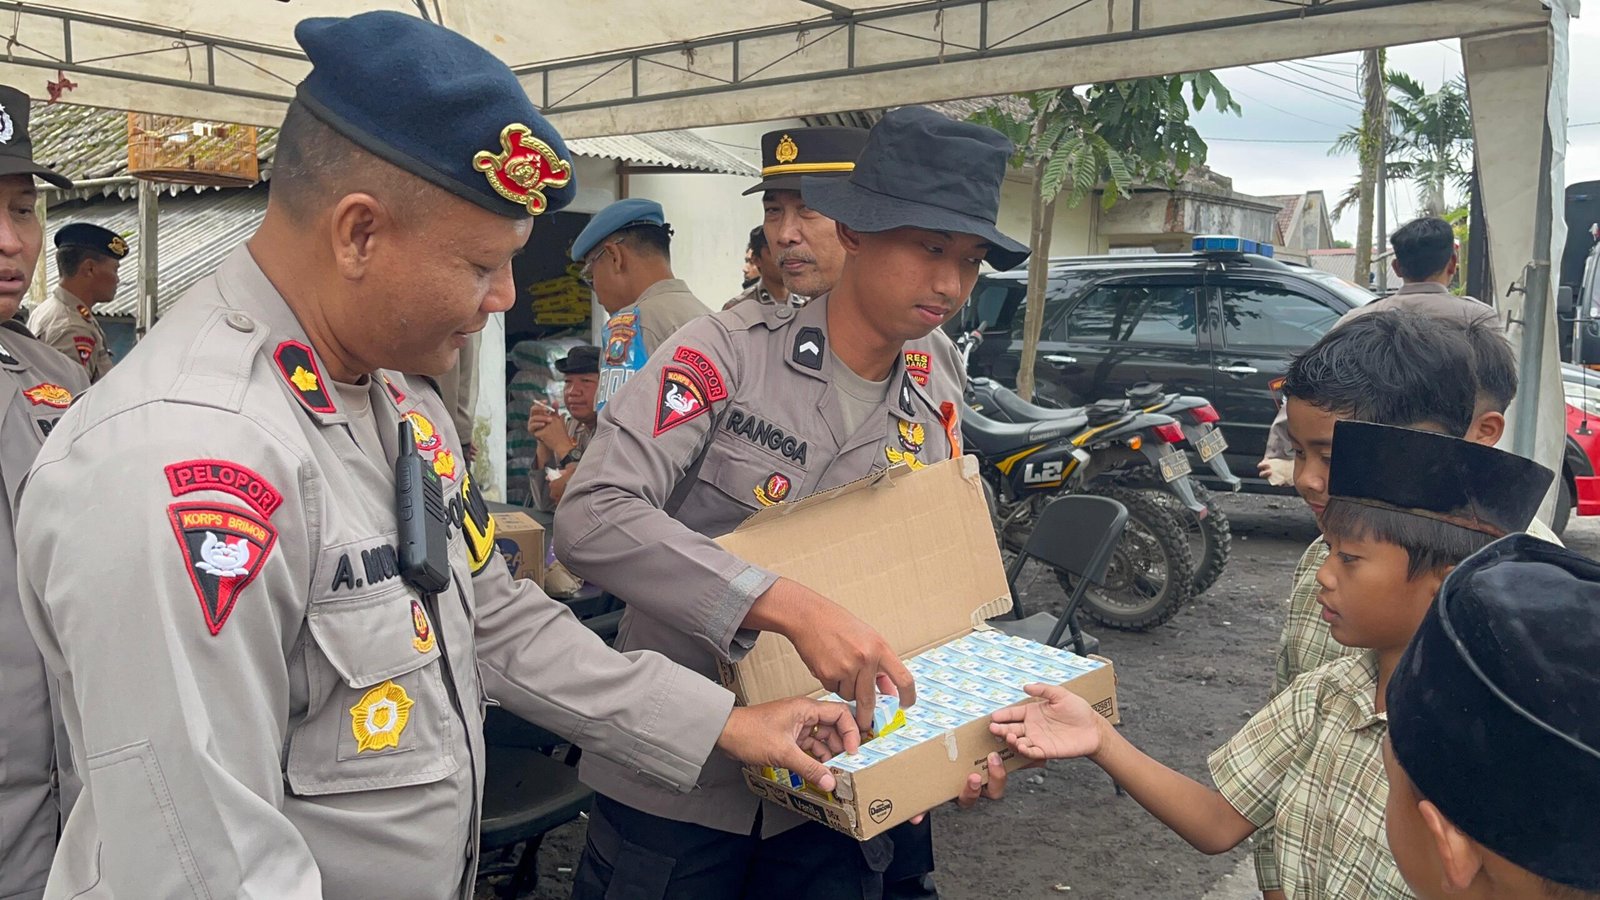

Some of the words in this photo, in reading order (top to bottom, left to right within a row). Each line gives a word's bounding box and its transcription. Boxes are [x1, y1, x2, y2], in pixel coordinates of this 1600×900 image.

[681, 350, 722, 397] PELOPOR
[725, 409, 808, 465] RANGGA
[177, 465, 274, 509] PELOPOR
[183, 513, 223, 526] KORPS
[227, 517, 266, 541] BRIMOB
